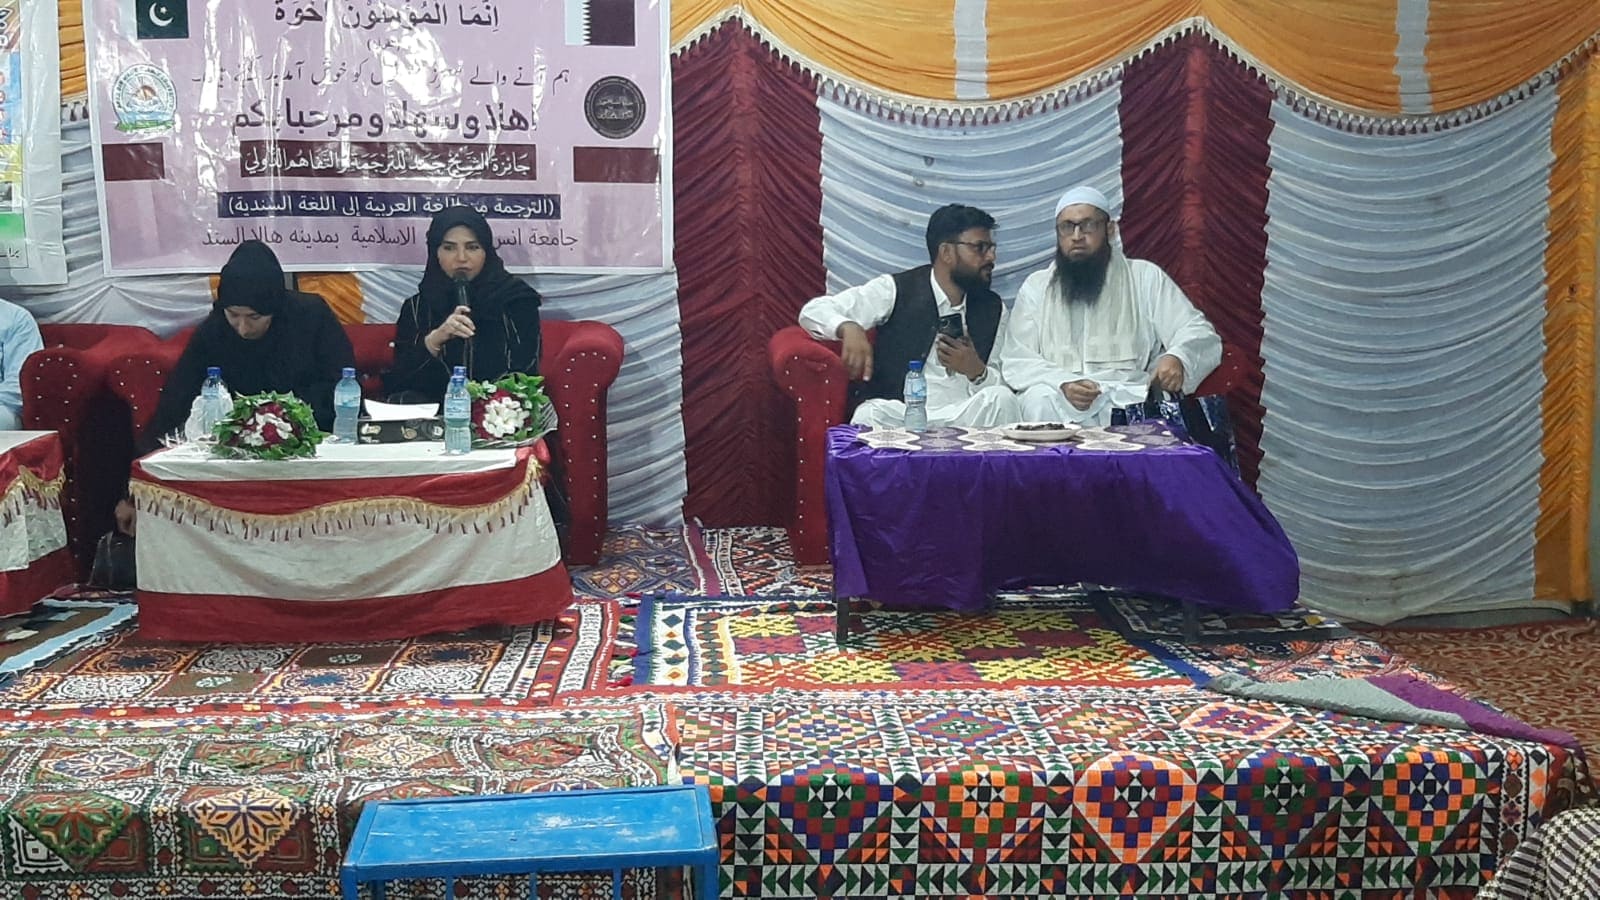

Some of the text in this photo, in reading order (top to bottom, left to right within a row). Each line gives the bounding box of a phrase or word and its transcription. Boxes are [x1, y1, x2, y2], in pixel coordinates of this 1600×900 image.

[469, 64, 506, 86] والے
[298, 195, 337, 212] اللغة
[342, 196, 360, 217] إلى
[365, 196, 417, 217] العربية
[351, 226, 417, 249] الاسلامية
[528, 228, 579, 251] جامعة
